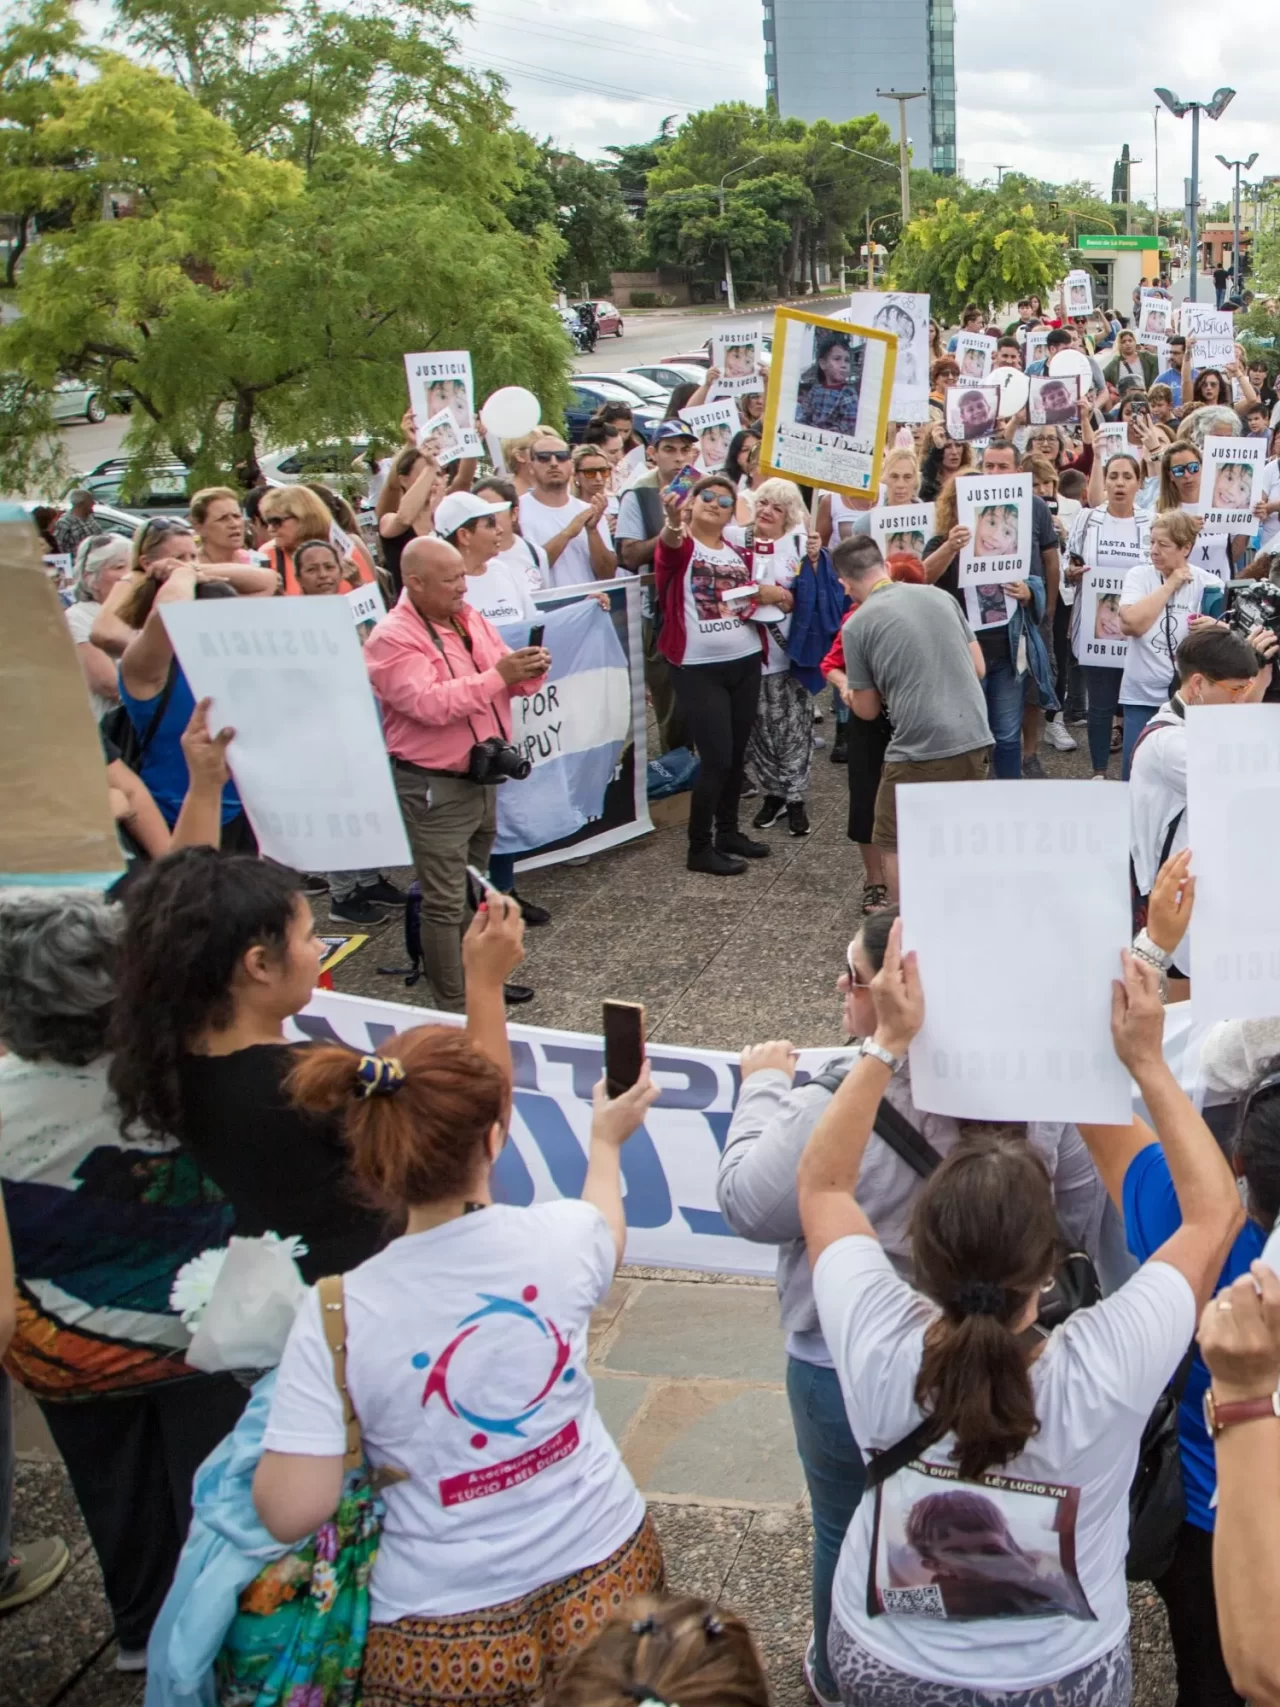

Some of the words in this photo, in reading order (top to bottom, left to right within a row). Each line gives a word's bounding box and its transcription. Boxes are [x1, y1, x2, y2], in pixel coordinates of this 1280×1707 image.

[1192, 314, 1230, 335] JUSTICIA
[719, 331, 758, 343] JUSTICIA
[962, 337, 991, 349] JUSTICIA
[416, 363, 467, 377] JUSTICIA
[717, 379, 734, 388] POR
[737, 376, 758, 388] LUCIO
[690, 409, 731, 426] JUSTICIA
[1212, 448, 1259, 459] JUSTICIA
[967, 487, 1023, 502] JUSTICIA
[879, 514, 928, 529] JUSTICIA
[1204, 513, 1222, 523] POR
[1226, 514, 1252, 524] LUCIO
[1202, 546, 1210, 561] X
[967, 560, 987, 574] POR
[992, 559, 1023, 572] LUCIO
[1091, 578, 1123, 590] JUSTI
[700, 620, 733, 634] LUCIO
[1087, 643, 1106, 655] POR
[522, 684, 560, 725] POR
[468, 1452, 537, 1485] Asociación
[539, 1434, 564, 1456] Civil
[505, 1465, 534, 1488] ABEL
[985, 1476, 1007, 1488] LEY
[1010, 1481, 1046, 1495] LUCIO
[1048, 1485, 1068, 1498] YA!
